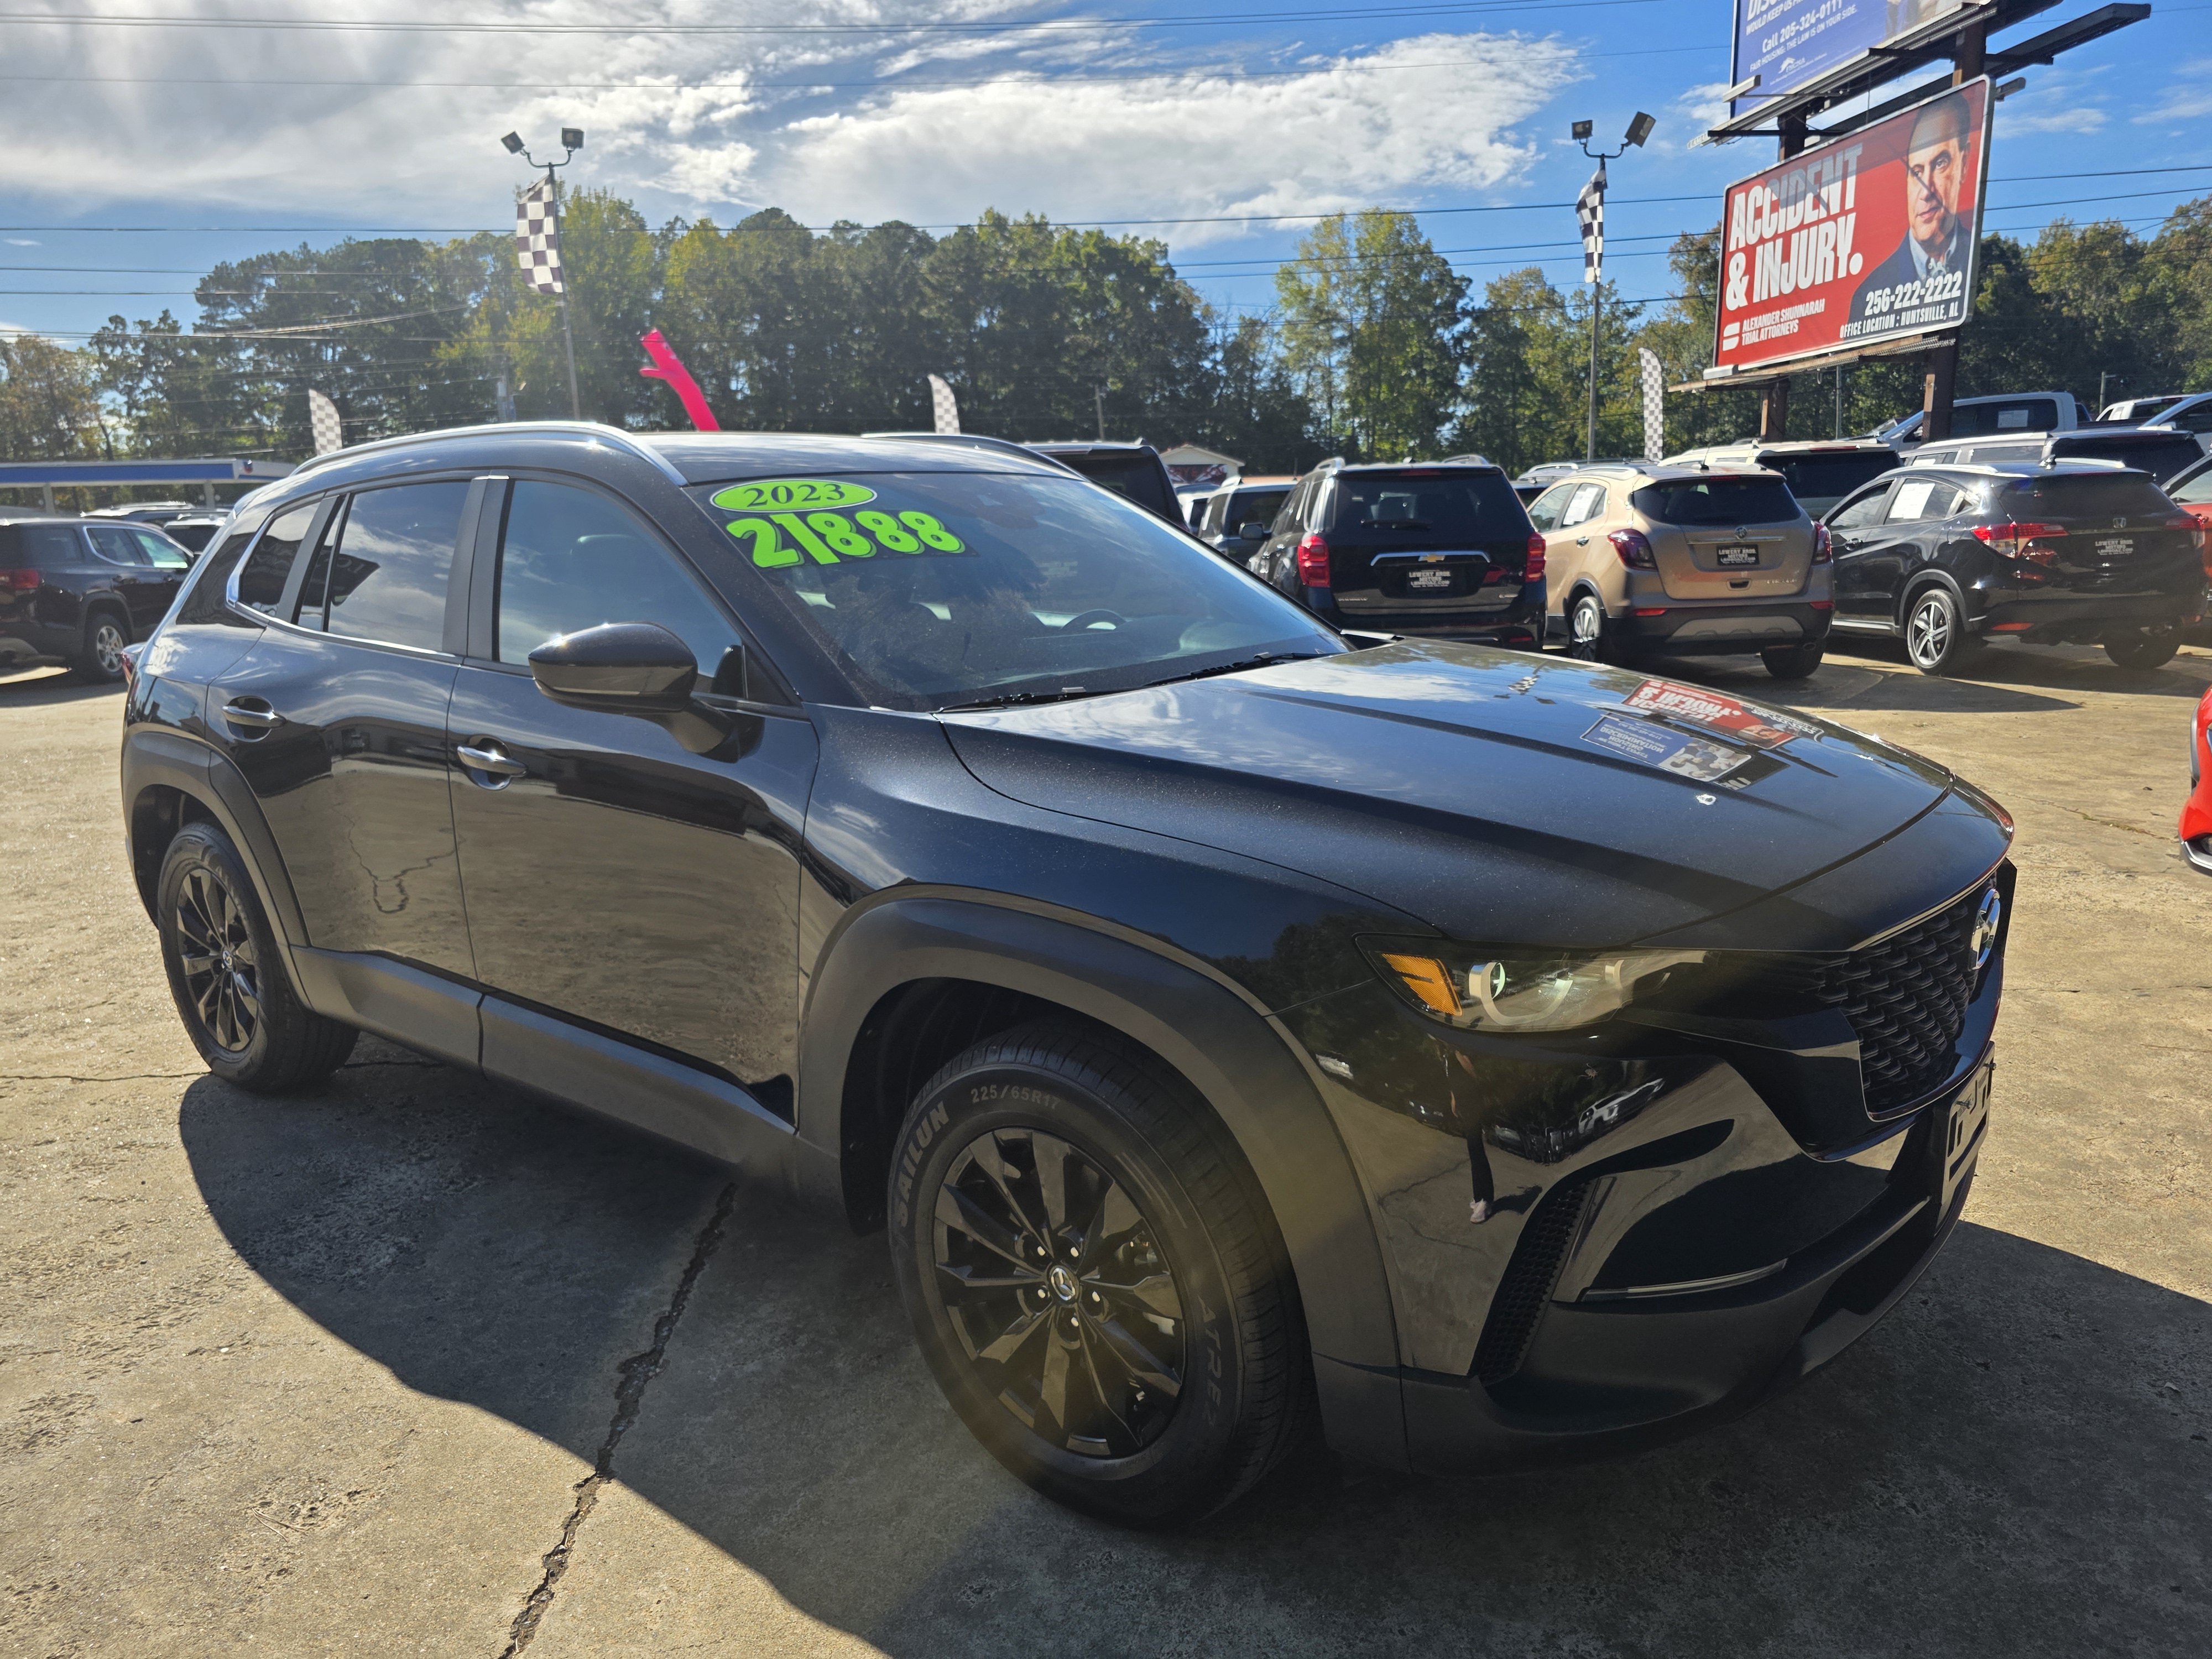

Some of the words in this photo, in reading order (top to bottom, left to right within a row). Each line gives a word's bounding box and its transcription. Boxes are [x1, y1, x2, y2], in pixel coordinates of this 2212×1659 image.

[1746, 14, 1767, 36] WOULD
[1767, 3, 1784, 23] KEEP
[1762, 32, 1779, 53] Call
[1780, 0, 1843, 44] 205-324-0111
[1750, 59, 1762, 73] FAIR
[1786, 38, 1798, 51] THE
[1797, 31, 1810, 45] LAW
[1810, 28, 1817, 37] IS
[1817, 23, 1825, 33] ON
[1825, 13, 1841, 28] YOUR
[1729, 142, 1863, 252] ACCIDENT
[1725, 252, 1749, 311] &
[1752, 212, 1864, 303] INJURY.
[1743, 310, 1780, 332] ALEXANDER
[1781, 298, 1825, 322] SHUNNARAH
[1864, 270, 1963, 316] 256-222-2222
[1742, 331, 1760, 346] TRIAL
[1760, 319, 1799, 341] ATTORNEYS
[1839, 320, 1862, 338] OFFICE
[1862, 314, 1895, 333] LOCATION
[1901, 304, 1947, 326] HUNTSVILLE,
[1948, 301, 1959, 317] AL
[743, 483, 846, 508] 2023
[726, 510, 966, 568] 21888
[971, 1084, 1061, 1110] 225/65R17
[894, 1100, 949, 1228] SAILUN
